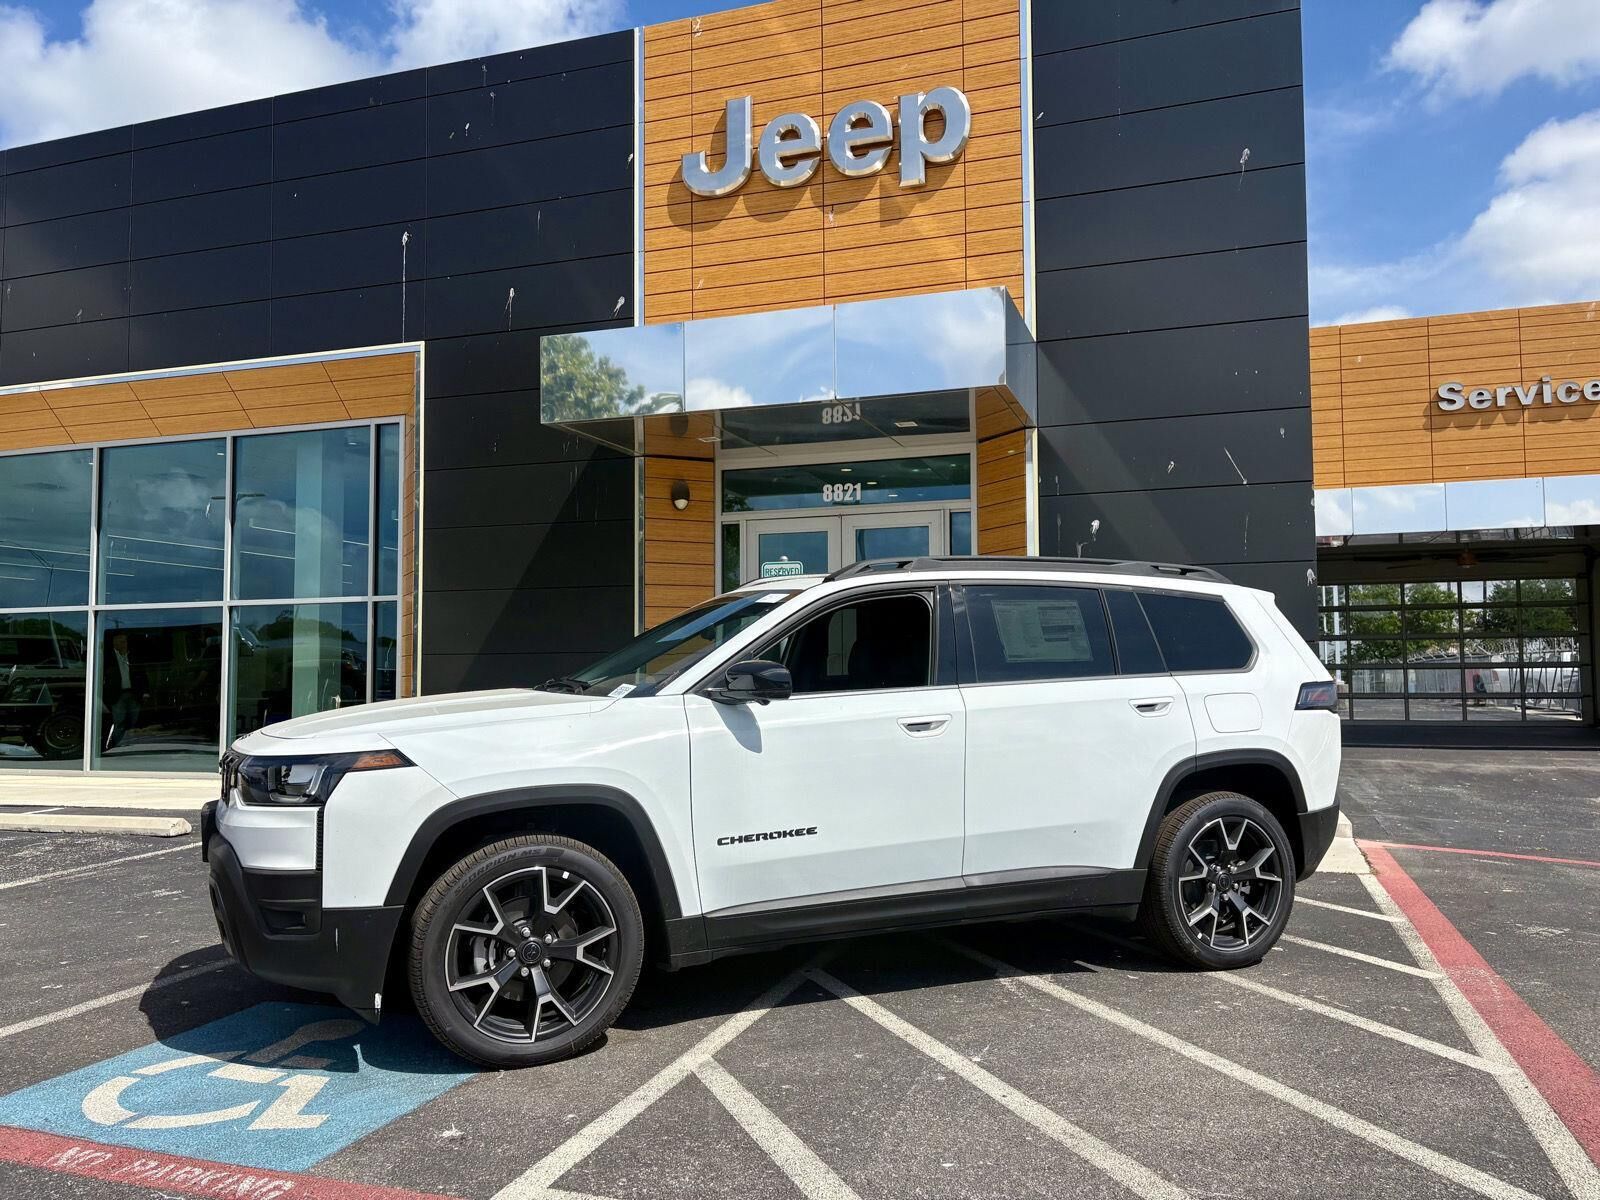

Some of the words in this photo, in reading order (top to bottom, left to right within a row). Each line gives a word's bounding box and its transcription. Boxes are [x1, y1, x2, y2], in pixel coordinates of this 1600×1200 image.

[681, 86, 971, 197] Jeep
[1437, 375, 1600, 411] Service
[823, 483, 861, 502] 8821
[765, 567, 800, 577] RESERVED
[717, 826, 818, 846] CHEROKEE
[454, 852, 517, 895] SCORPION
[46, 1146, 113, 1169] NO
[115, 1158, 295, 1200] PARKING
